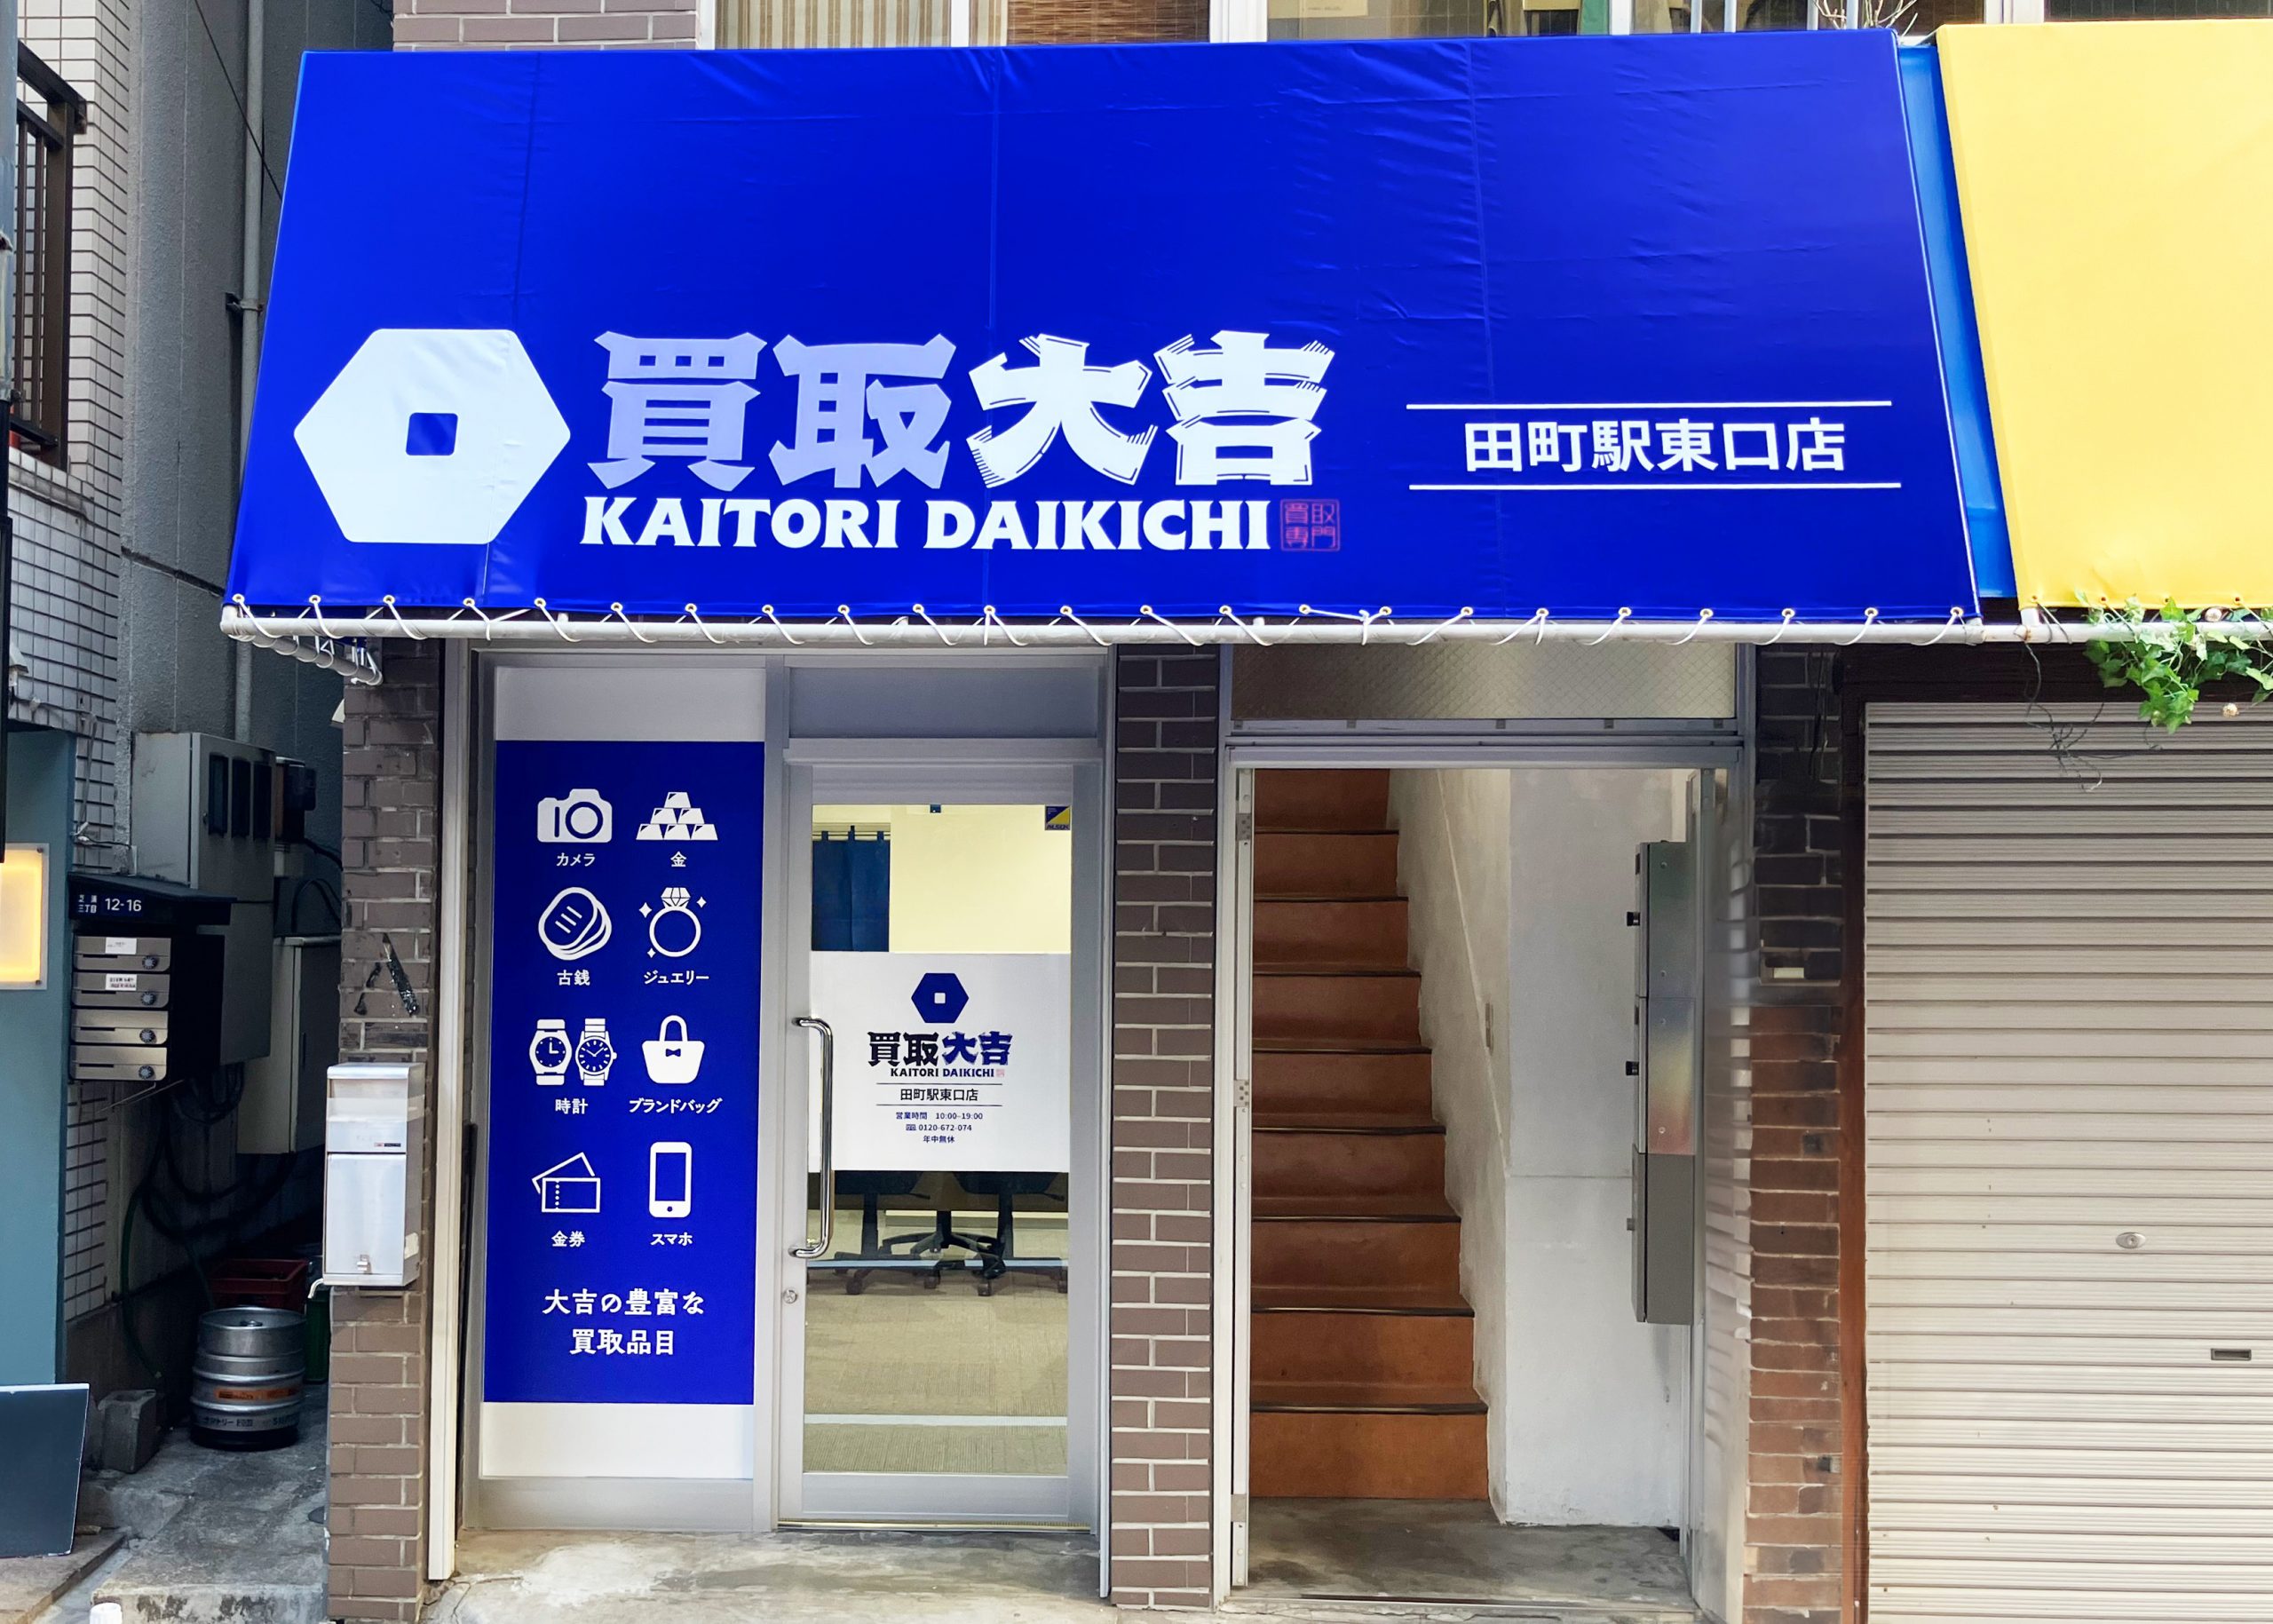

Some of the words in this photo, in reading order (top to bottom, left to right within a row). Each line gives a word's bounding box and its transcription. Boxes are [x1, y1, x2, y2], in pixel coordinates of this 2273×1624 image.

[587, 329, 1335, 489] 買取大吉
[1464, 416, 1845, 472] 田町駅東口店
[579, 495, 901, 549] KAITORI
[923, 499, 1271, 551] DAIKICHI
[556, 852, 596, 867] カメラ
[669, 851, 687, 867] 金
[105, 898, 142, 912] 12-16
[557, 969, 590, 986] 古銭
[644, 970, 709, 986] ジュエリー
[867, 1030, 1013, 1067] 買取大吉
[890, 1067, 939, 1077] KAITORI
[942, 1067, 994, 1078] DAIKICHI
[899, 1088, 978, 1102] 田町駅東口店
[555, 1097, 589, 1115] 時計
[629, 1097, 723, 1114] ブランドバッグ
[923, 1135, 955, 1144] 年中無休
[550, 1230, 586, 1248] 金券
[650, 1232, 693, 1247] スマホ
[542, 1287, 704, 1316] 大吉の豊富な
[569, 1328, 674, 1356] 買取品目
